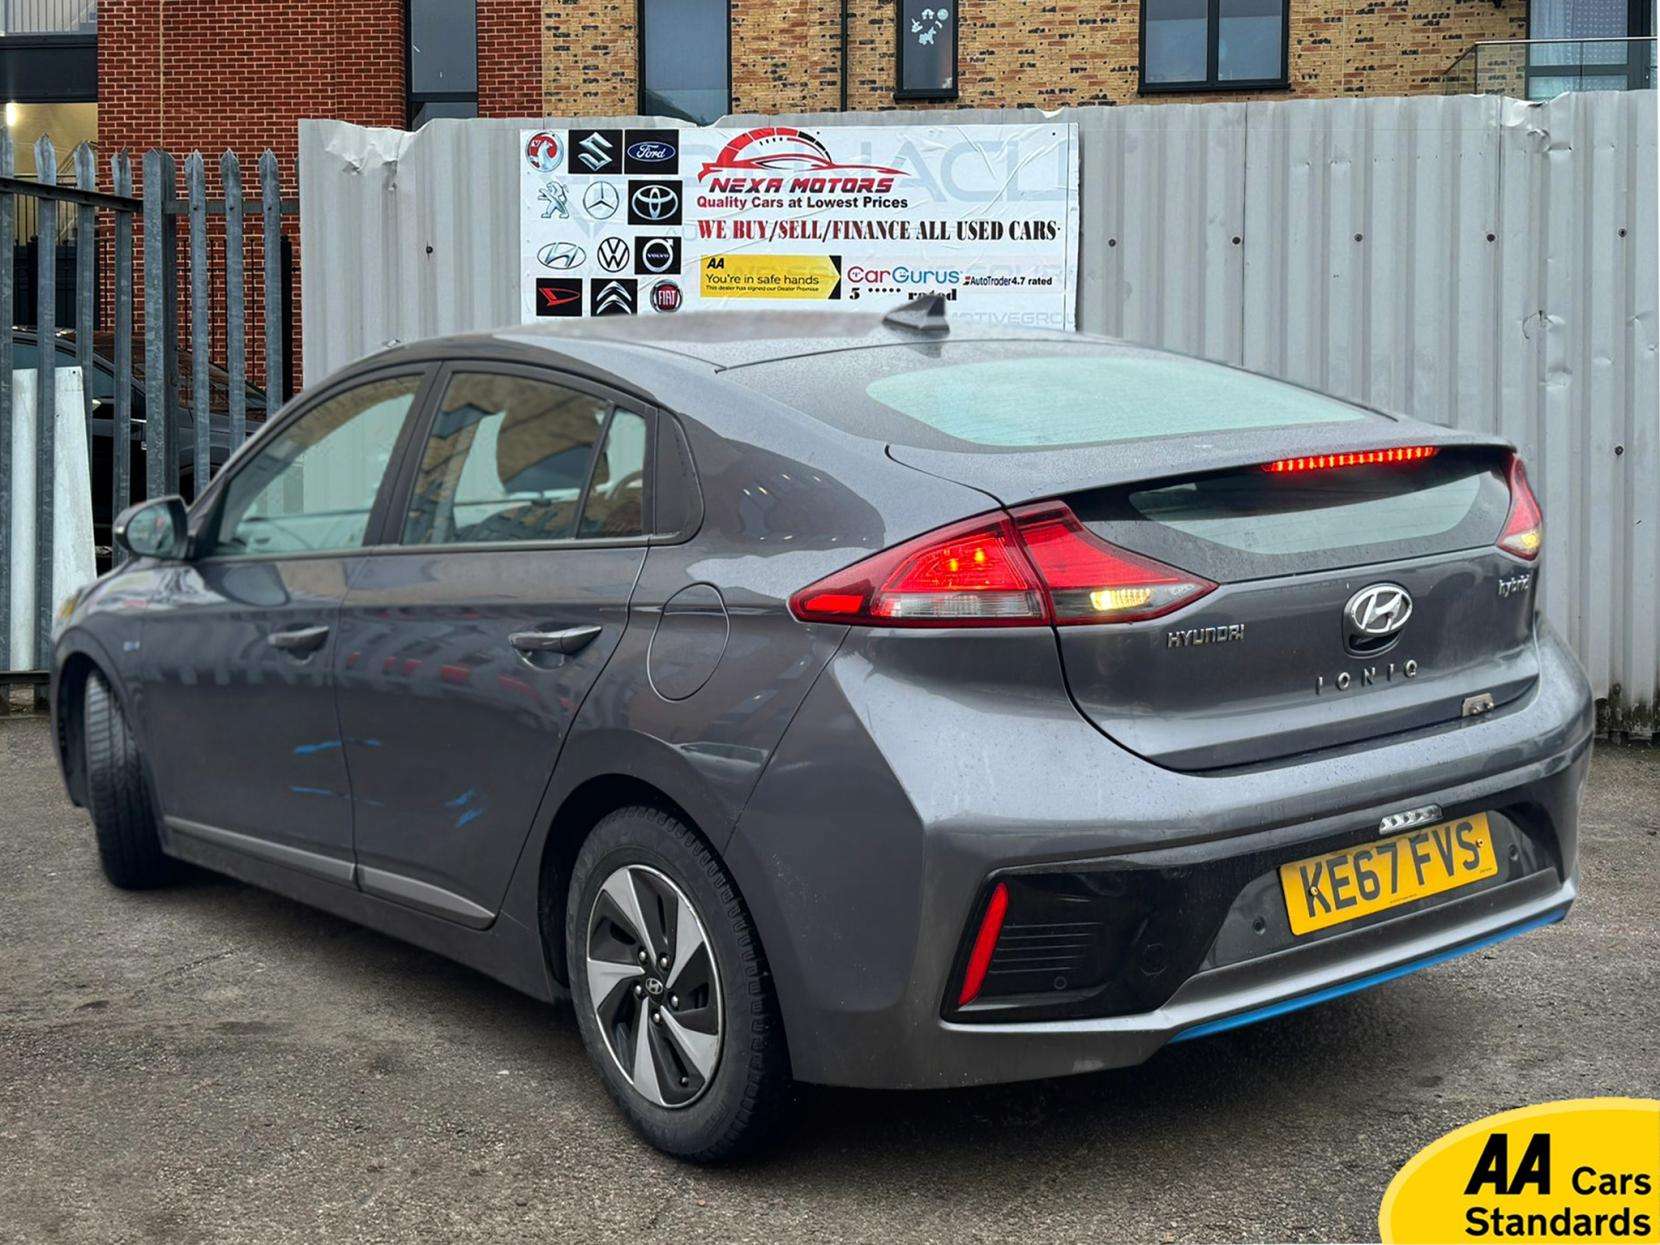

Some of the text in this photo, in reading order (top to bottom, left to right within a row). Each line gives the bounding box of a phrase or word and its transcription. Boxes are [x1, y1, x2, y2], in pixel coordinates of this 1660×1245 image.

[636, 144, 665, 158] Ford
[709, 177, 895, 194] NEXA MOTORS
[696, 195, 908, 211] Quality Cars at Lowest Prices
[697, 219, 727, 240] WE
[916, 220, 951, 241] ALL
[956, 220, 1004, 241] USED
[706, 257, 725, 269] AA
[705, 273, 820, 285] You're in safe hands
[847, 266, 960, 284] CarGurus
[1011, 276, 1026, 286] 4.7
[1028, 276, 1053, 286] rated
[658, 290, 676, 306] FIAT
[849, 287, 860, 300] 5
[1498, 573, 1531, 598] hybrid
[1167, 623, 1245, 648] HYUNDAI
[1315, 660, 1418, 695] IONIQ
[1299, 821, 1481, 918] KE67 FVS
